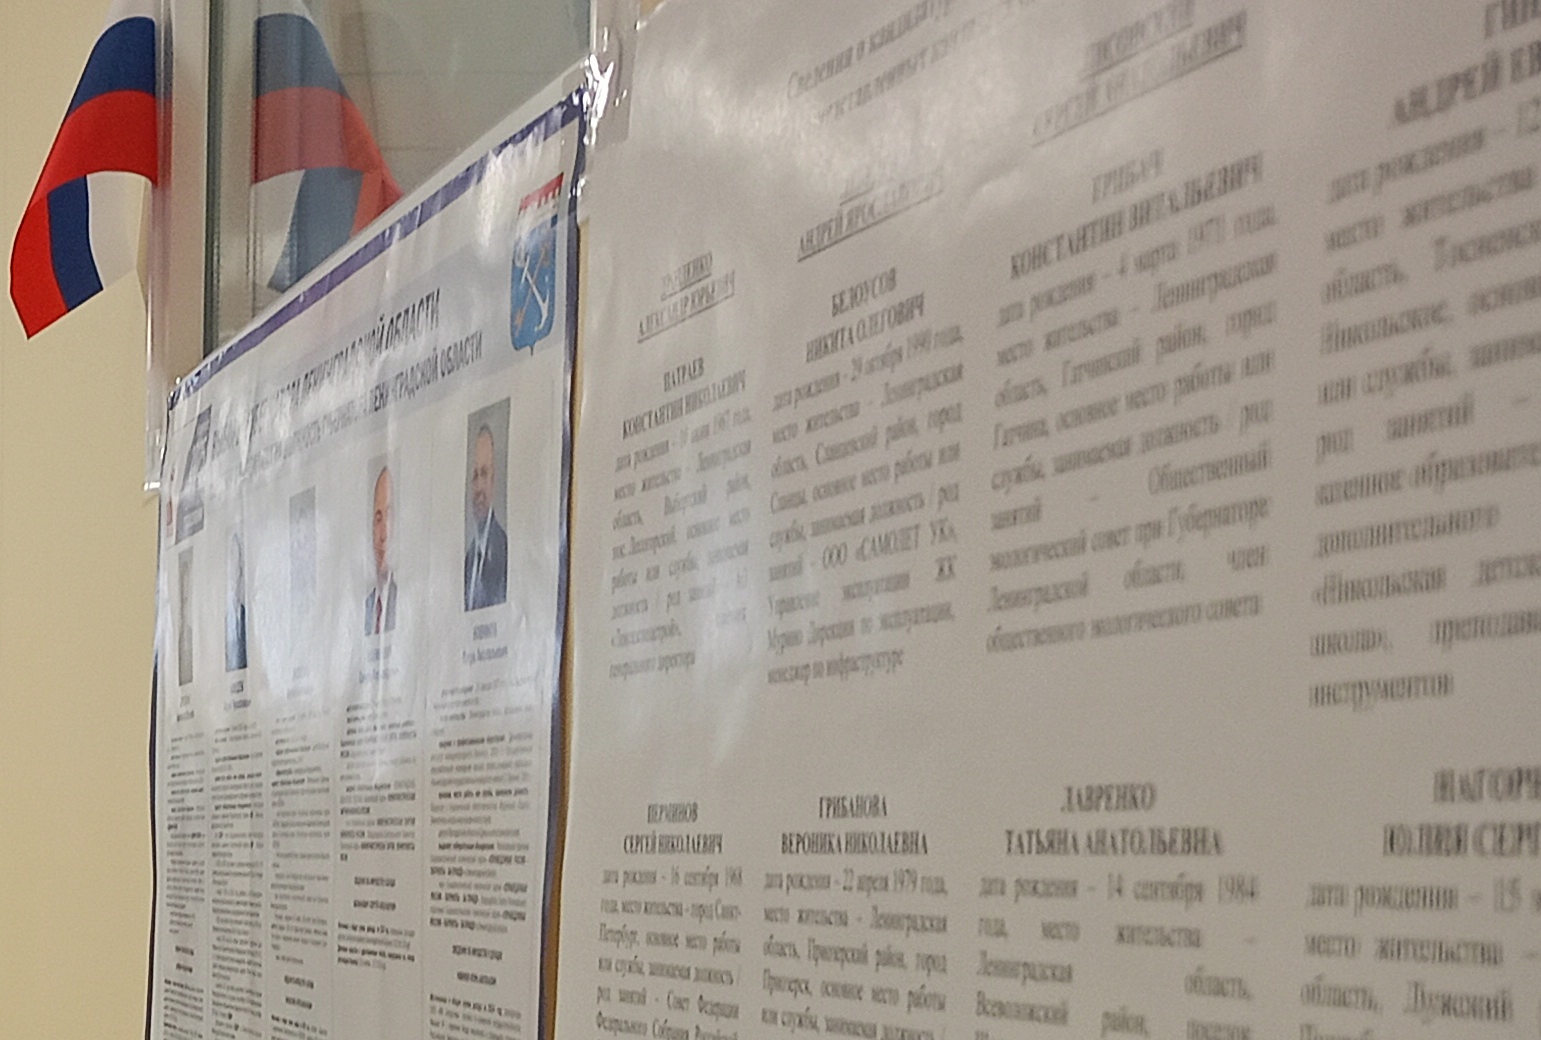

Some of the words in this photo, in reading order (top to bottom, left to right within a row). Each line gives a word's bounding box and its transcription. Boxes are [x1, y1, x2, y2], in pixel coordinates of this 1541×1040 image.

[1010, 209, 1124, 280] КОНСТАНТИН
[1128, 153, 1264, 231] ВИТАЛЬЕВИЧ
[832, 266, 897, 317] БЕЛОУСОВ
[385, 287, 441, 350] ОБЛАСТИ
[806, 326, 854, 363] НИКИТА
[856, 292, 925, 341] ОЛЕГОВИЧ
[440, 331, 483, 378] ОБЛАСТИ
[664, 357, 704, 392] ПАТРАЕВ
[623, 398, 683, 440] КОНСТАНТИН
[819, 794, 887, 819] ГРИБАНОВА
[1060, 782, 1157, 812] ЛАВРЕНКО
[623, 830, 656, 854] СЕРГЕЙ
[658, 833, 723, 854] НИКОЛАЕВИЧ
[781, 831, 842, 854] ВЕРОНИКА
[844, 830, 928, 854] НИКОЛАЕВНА
[1005, 828, 1081, 855] ТАТЬЯНА
[1086, 827, 1223, 856] АНАТОЛЬЕВНА
